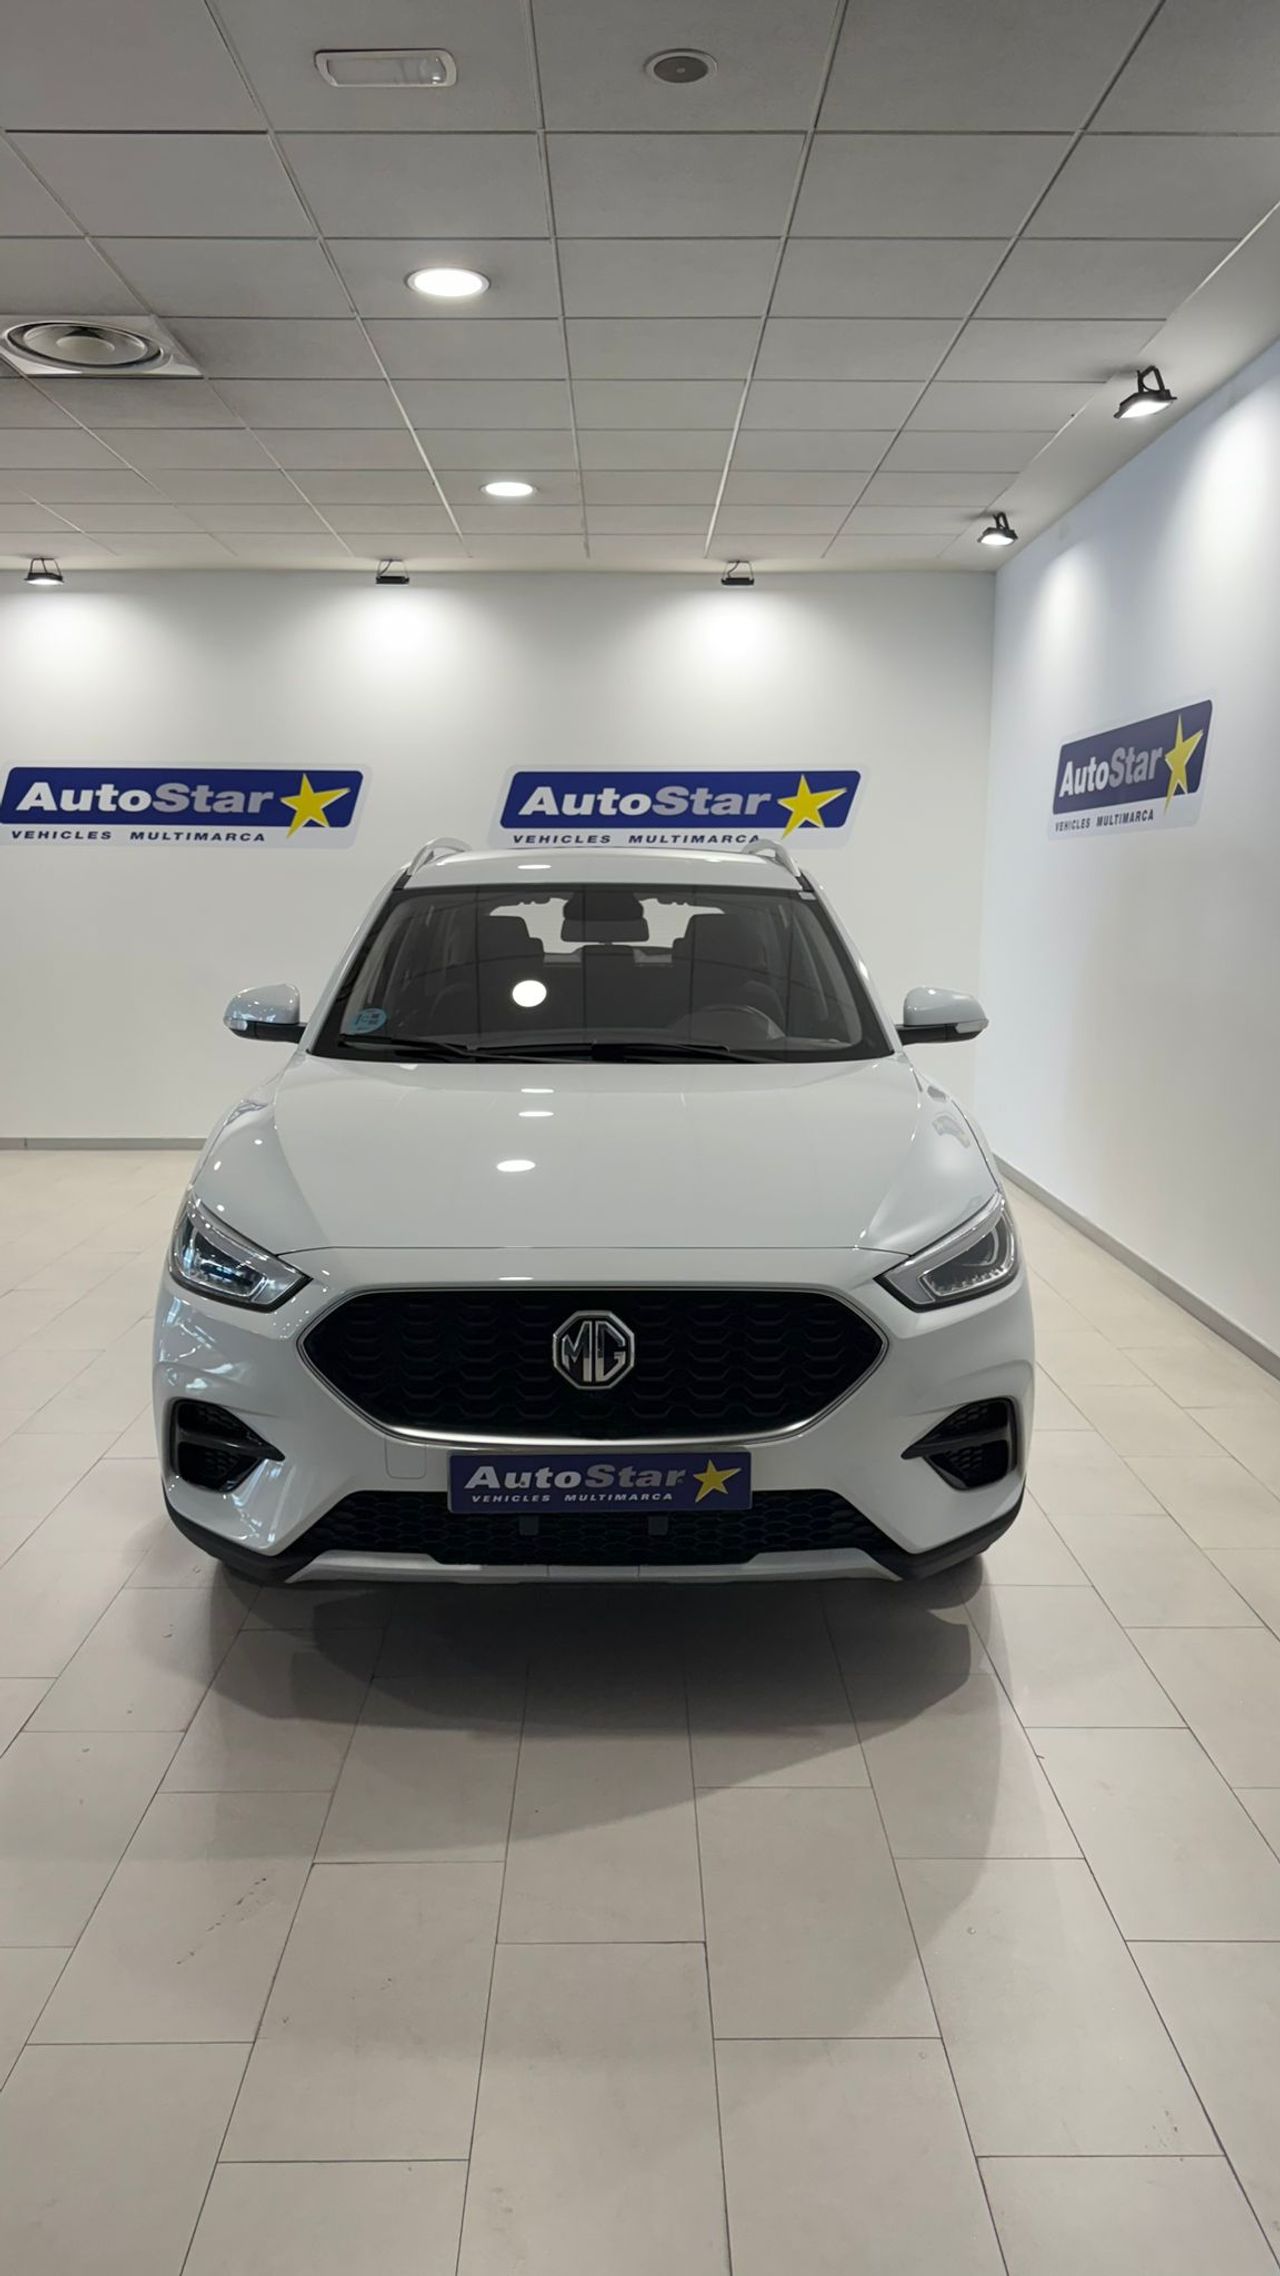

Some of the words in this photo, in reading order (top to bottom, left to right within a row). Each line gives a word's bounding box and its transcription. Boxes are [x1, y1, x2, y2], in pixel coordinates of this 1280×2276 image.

[1058, 746, 1164, 798] AutoStar
[15, 781, 274, 814] AutoStar
[517, 785, 772, 816] AutoStar
[1055, 817, 1091, 832] VEHICLES
[1096, 809, 1154, 827] MULTIMARCA
[11, 830, 112, 840] VEHICLES
[130, 831, 265, 842] MULTIMARCA
[513, 834, 611, 844] VEHICLES
[629, 834, 760, 844] MULTIMARCA
[561, 1320, 626, 1383] MG
[464, 1464, 687, 1489] AutoStar
[471, 1494, 551, 1503] VEHICLES
[564, 1493, 673, 1502] MULTIMARCA
